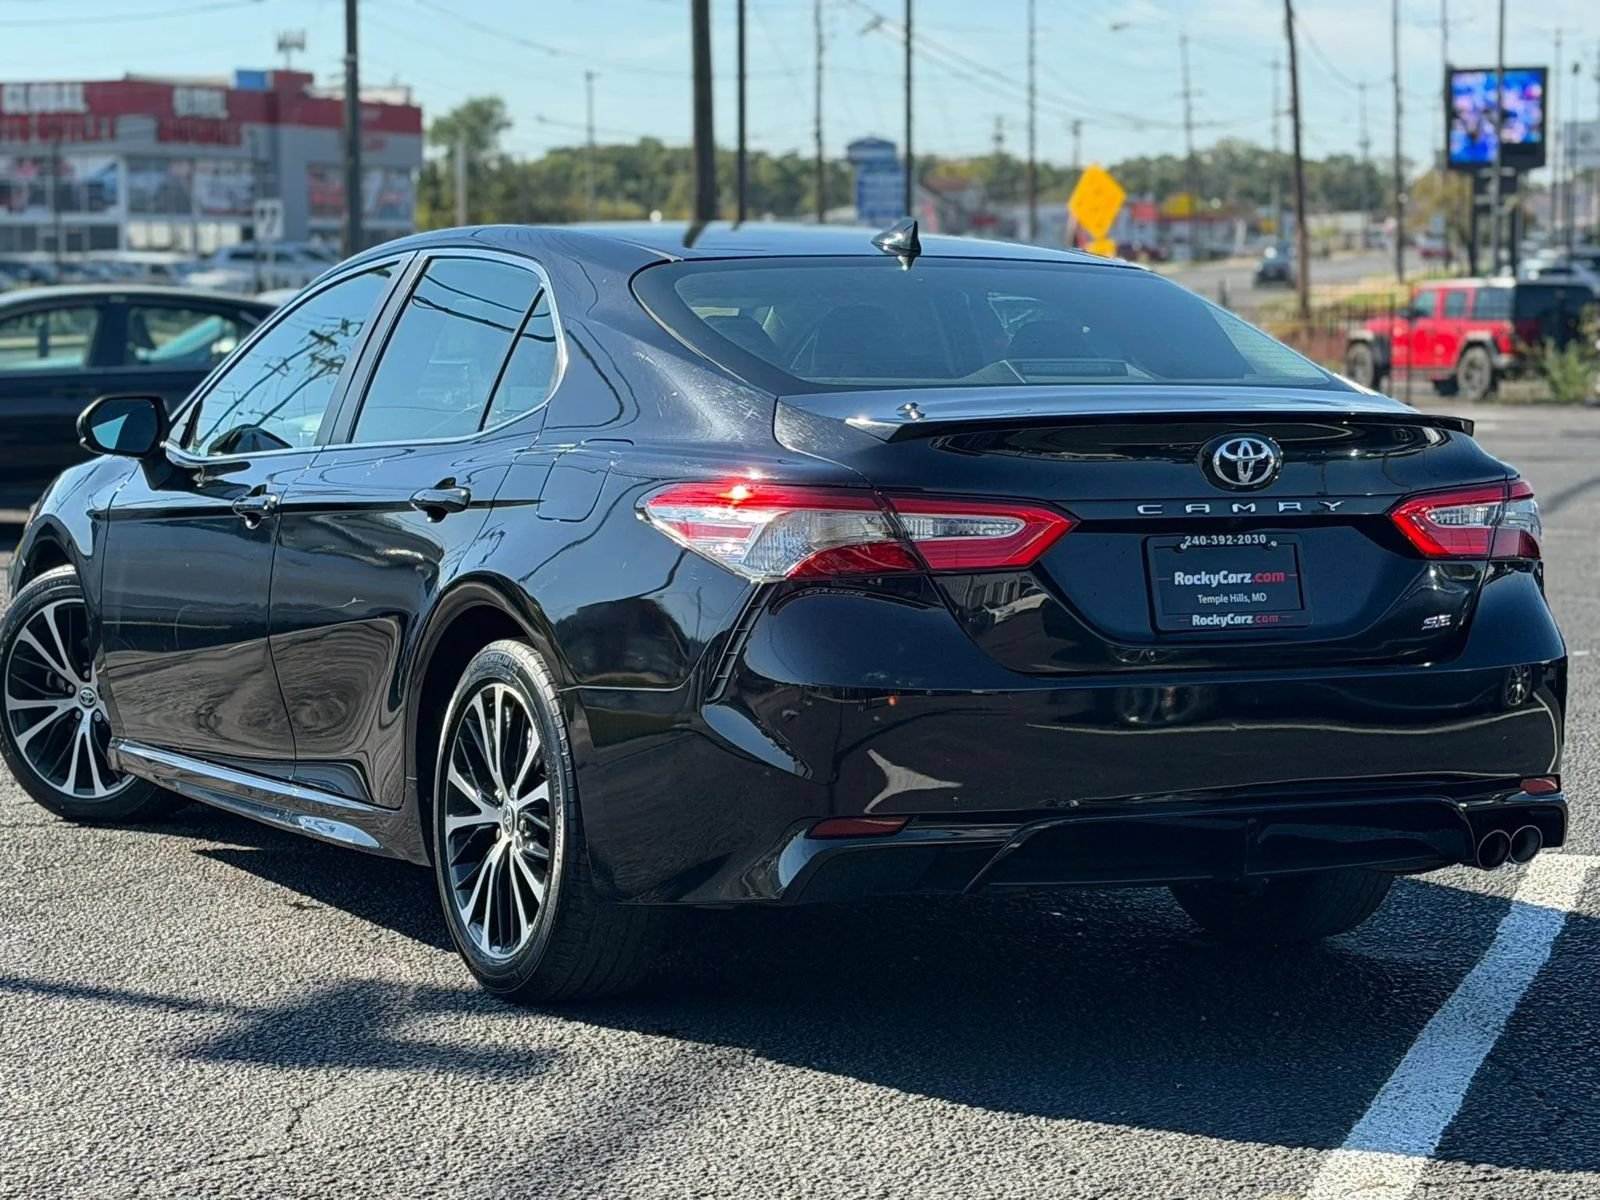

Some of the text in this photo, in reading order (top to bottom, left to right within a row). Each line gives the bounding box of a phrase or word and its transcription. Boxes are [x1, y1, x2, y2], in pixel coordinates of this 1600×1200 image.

[1136, 500, 1344, 515] CAMRY
[1184, 534, 1267, 546] 240-392-2030
[1174, 570, 1285, 587] RockyCarz.com
[1197, 592, 1267, 605] Temple Hills, MD
[1192, 613, 1279, 627] RockyCarz.com
[1421, 614, 1452, 630] SE
